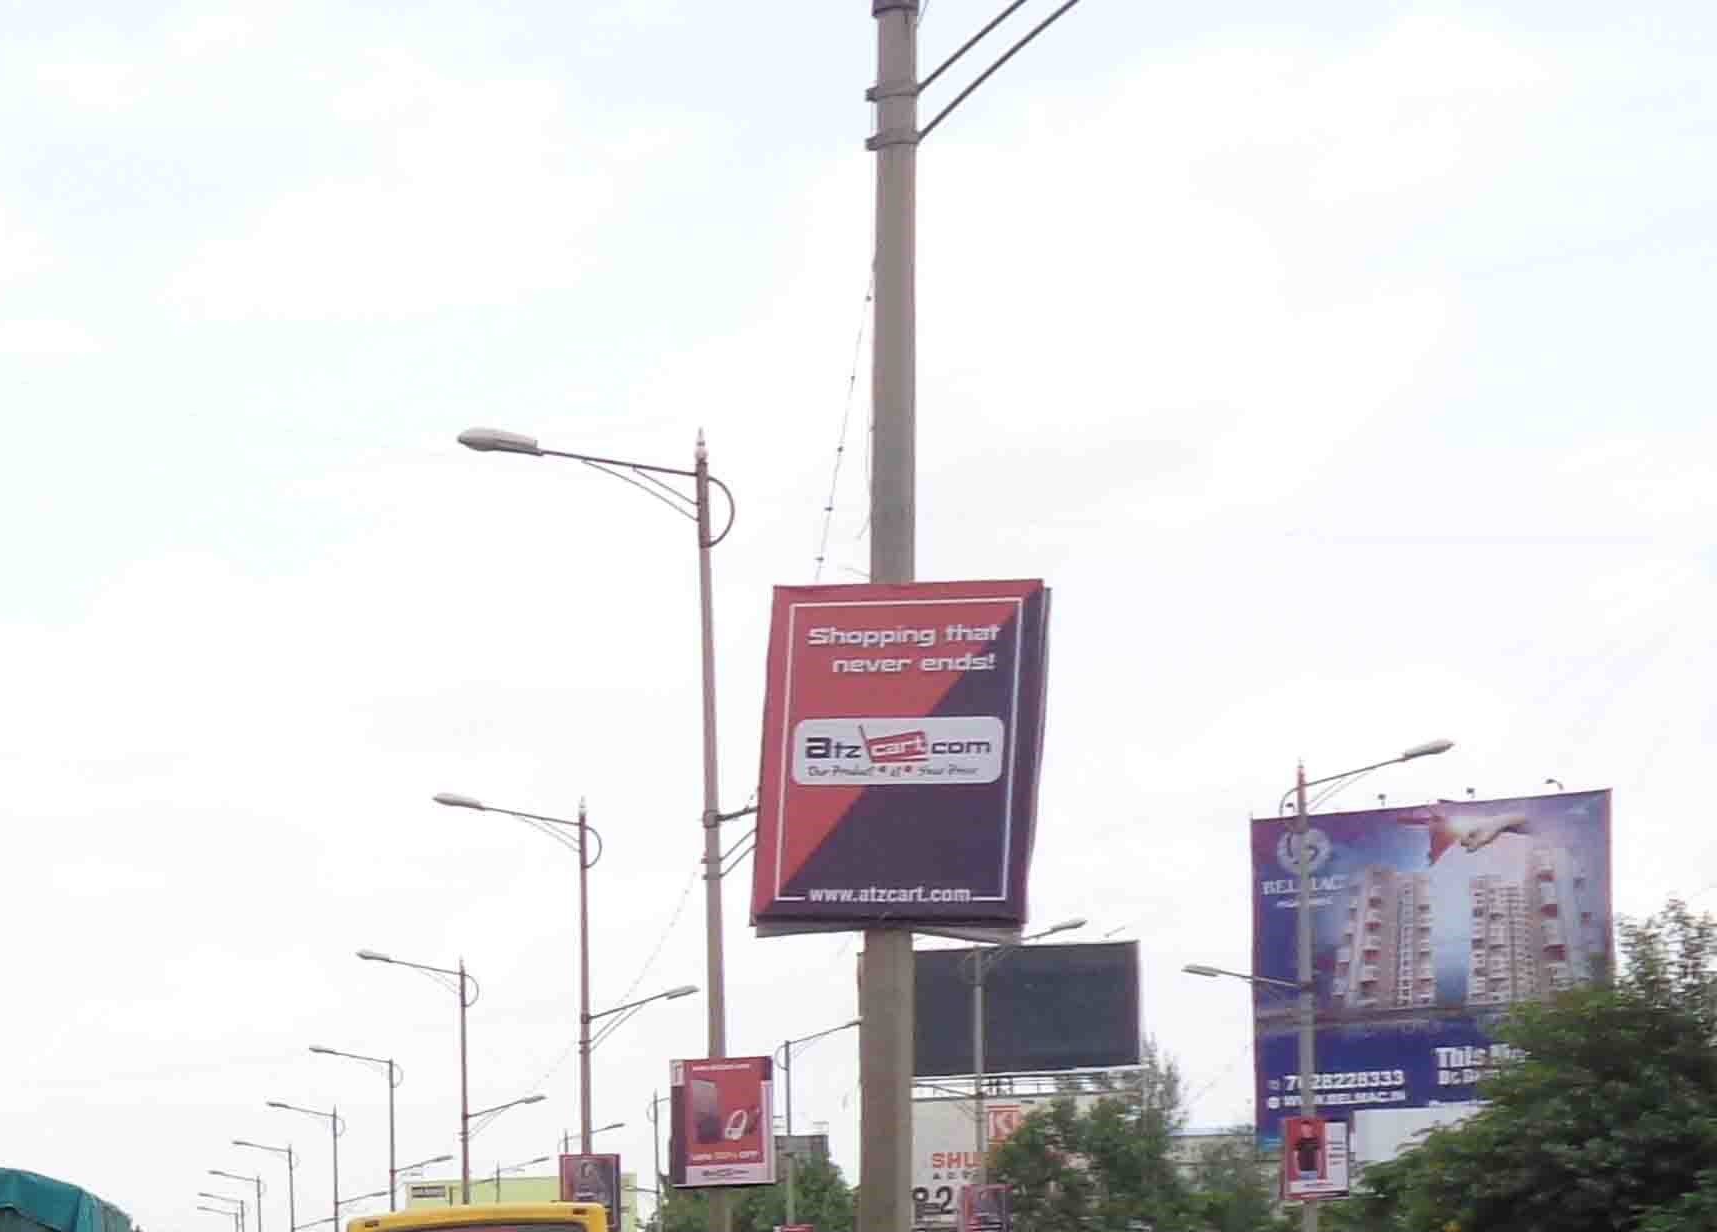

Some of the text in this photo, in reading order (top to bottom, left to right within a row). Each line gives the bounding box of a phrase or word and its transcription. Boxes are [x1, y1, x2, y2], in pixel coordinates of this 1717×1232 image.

[807, 624, 1002, 648] Shopping that
[832, 653, 996, 673] never ends!
[809, 886, 971, 903] www.atzcart.com
[1284, 1070, 1405, 1091] 728228333
